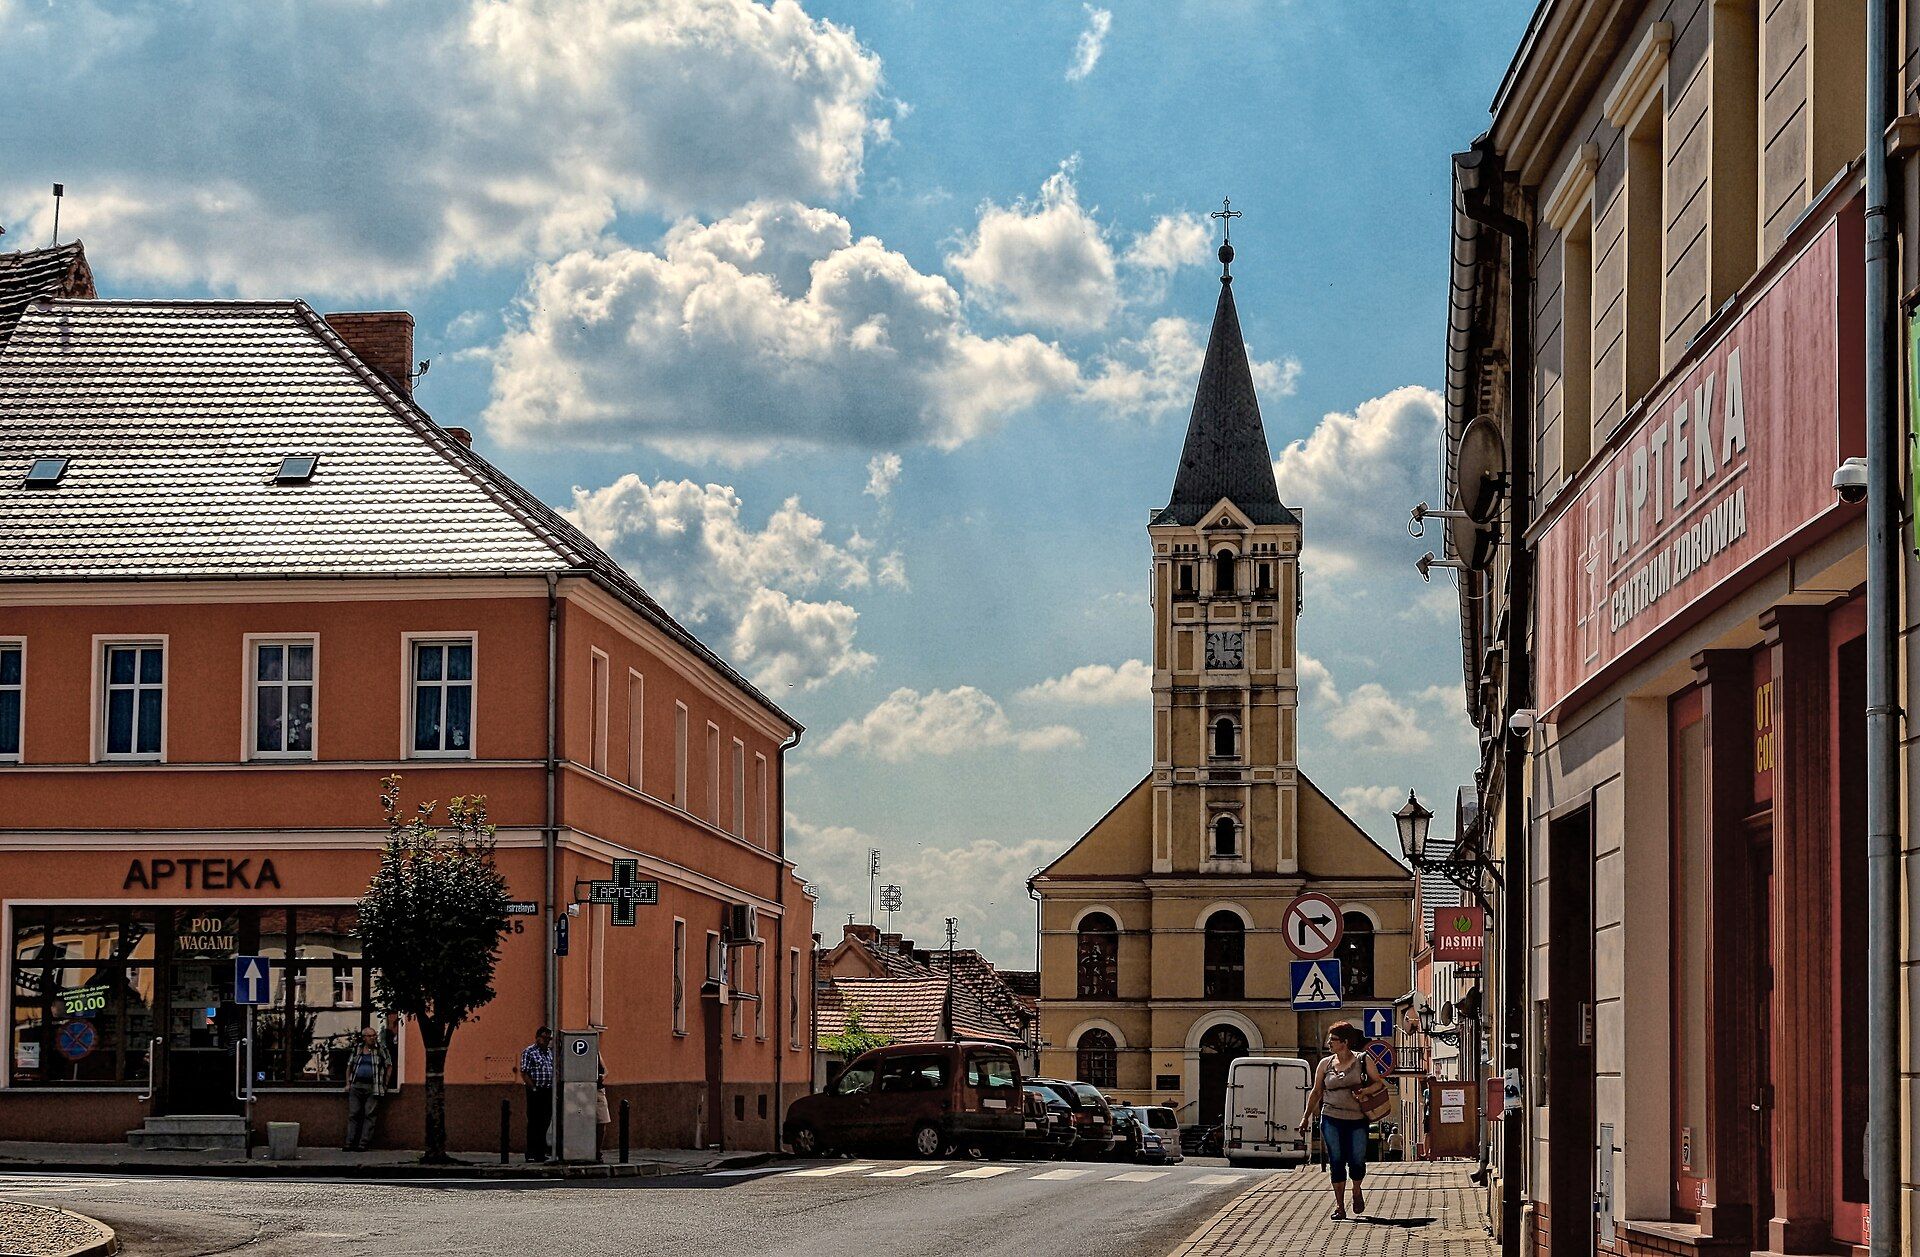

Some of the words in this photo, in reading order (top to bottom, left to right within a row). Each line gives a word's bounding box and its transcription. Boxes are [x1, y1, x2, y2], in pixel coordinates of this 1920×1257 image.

[1612, 346, 1746, 564] APTEKA
[1611, 547, 1670, 633] CENTRUM
[1673, 485, 1747, 586] ZDROWIA
[1756, 681, 1773, 731] OT
[123, 858, 281, 890] APTEKA
[600, 886, 648, 898] APTEKA
[192, 918, 222, 933] POD
[179, 935, 234, 950] WAGAMI
[1440, 935, 1484, 950] JASMIN
[66, 996, 106, 1014] 20.00
[576, 1041, 585, 1054] P
